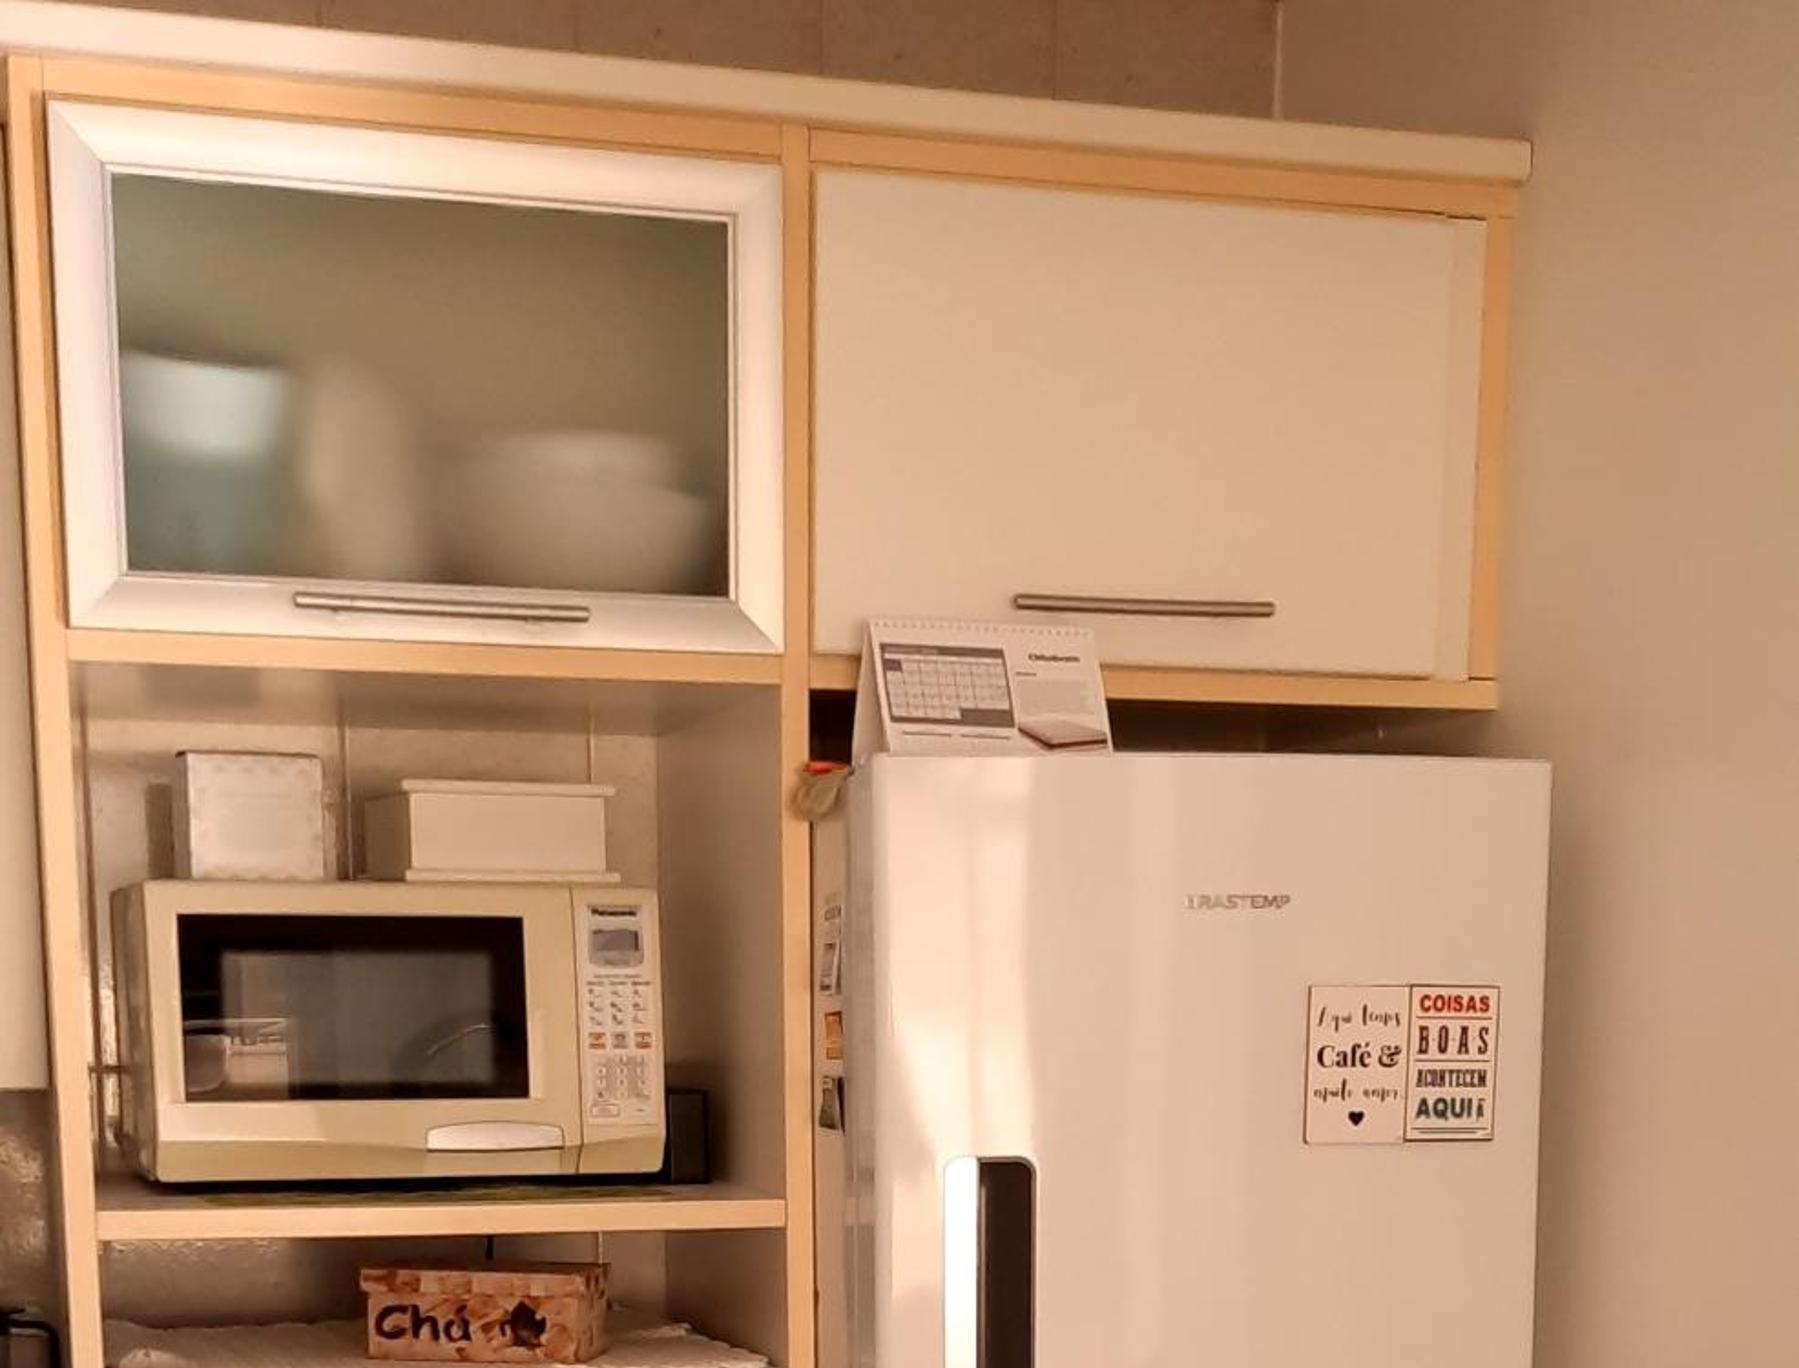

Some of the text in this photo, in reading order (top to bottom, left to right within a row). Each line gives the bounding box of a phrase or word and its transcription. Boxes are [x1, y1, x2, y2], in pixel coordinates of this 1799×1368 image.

[1419, 994, 1490, 1013] COISAS
[1317, 1041, 1401, 1068] Café &
[1415, 1068, 1488, 1088] ACONTECEM
[374, 1304, 472, 1342] Chá
